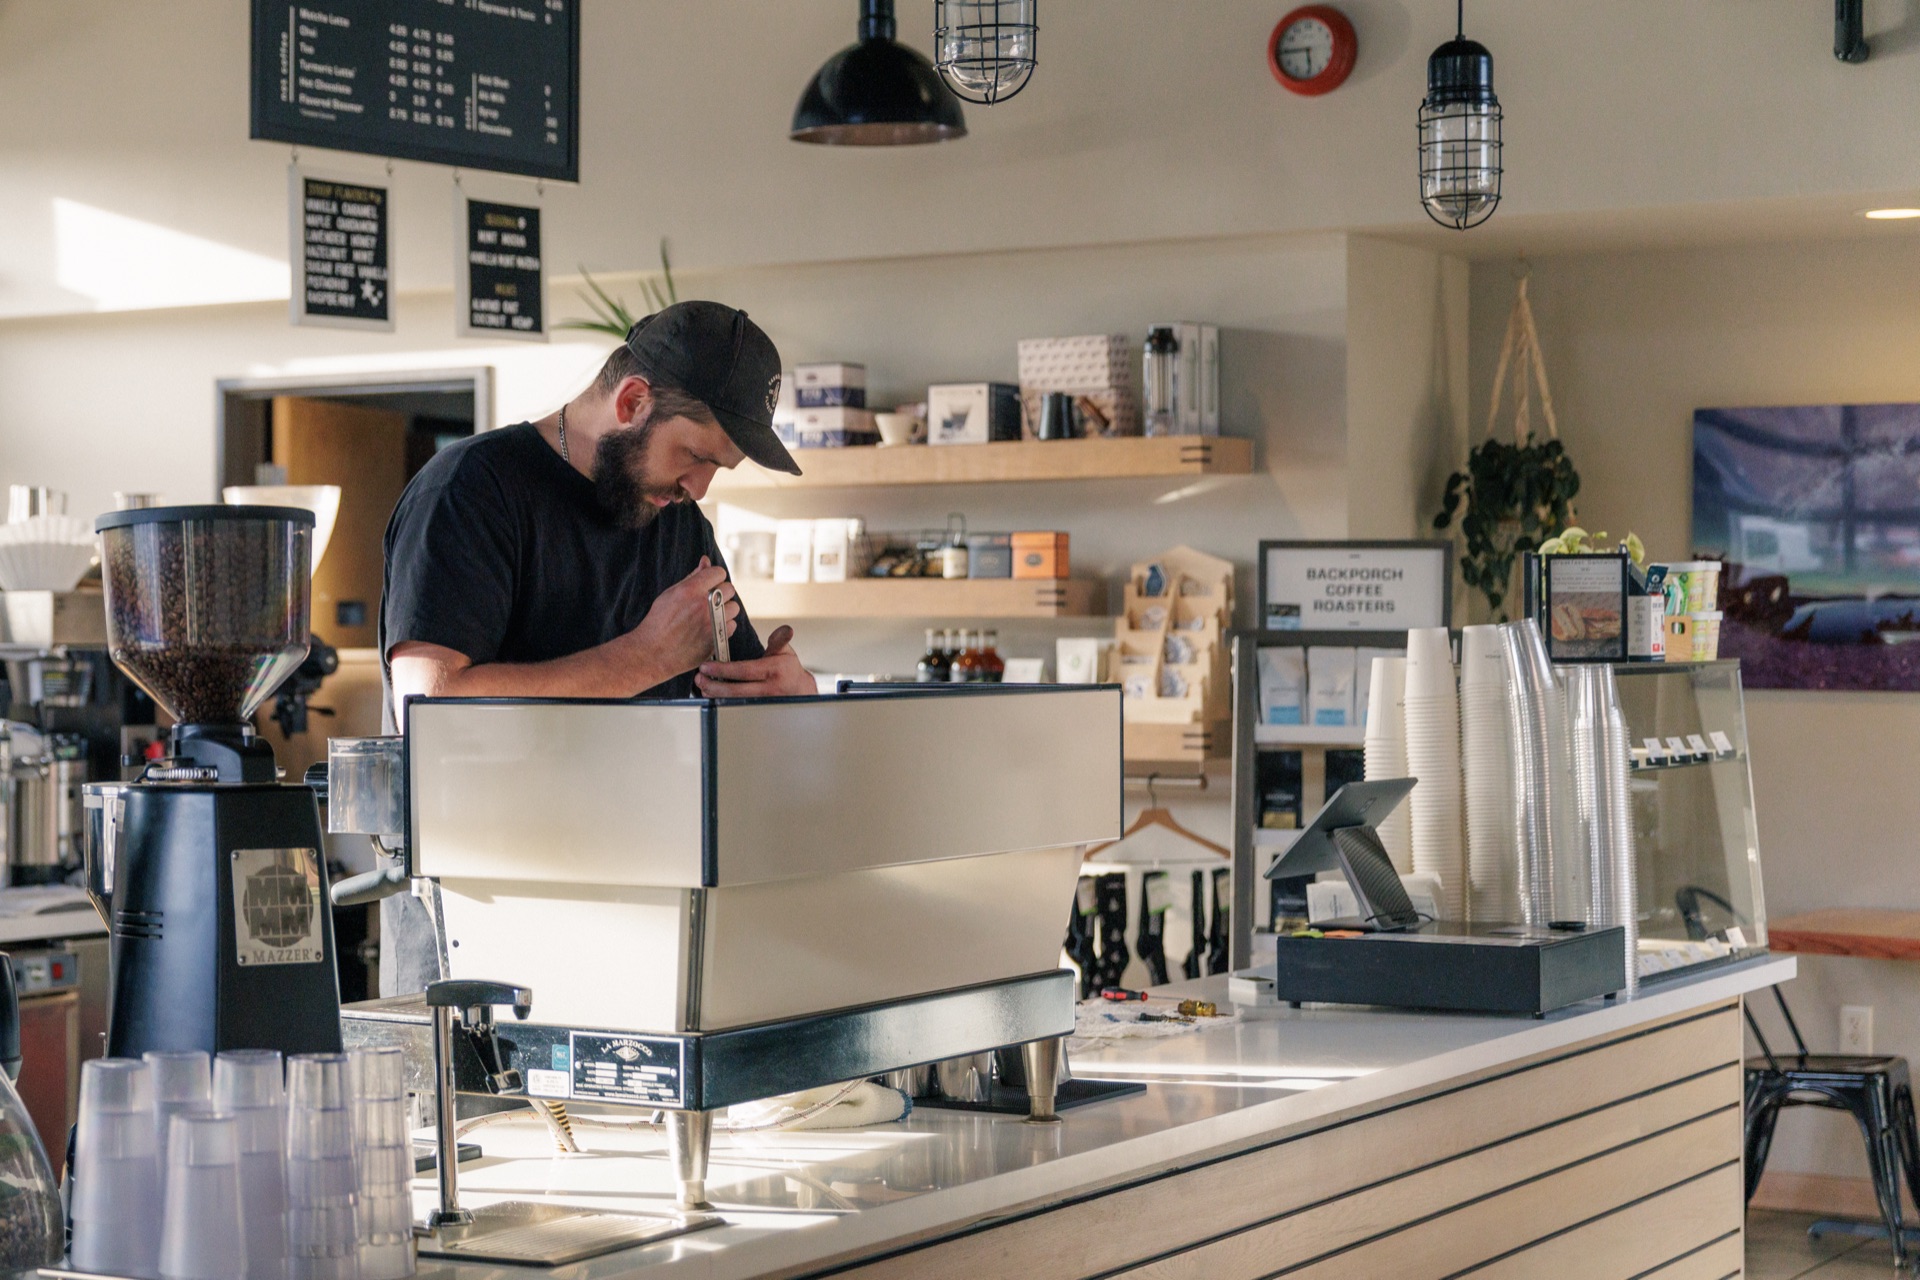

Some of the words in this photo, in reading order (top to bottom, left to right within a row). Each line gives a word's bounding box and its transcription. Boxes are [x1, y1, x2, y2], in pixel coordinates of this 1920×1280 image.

[1306, 568, 1403, 580] BACKPORCH
[1326, 584, 1383, 597] COFFEE
[1313, 600, 1395, 613] ROASTERS
[253, 948, 310, 963] MAZZER
[600, 1042, 613, 1054] LA
[612, 1038, 653, 1057] MARZOCCO
